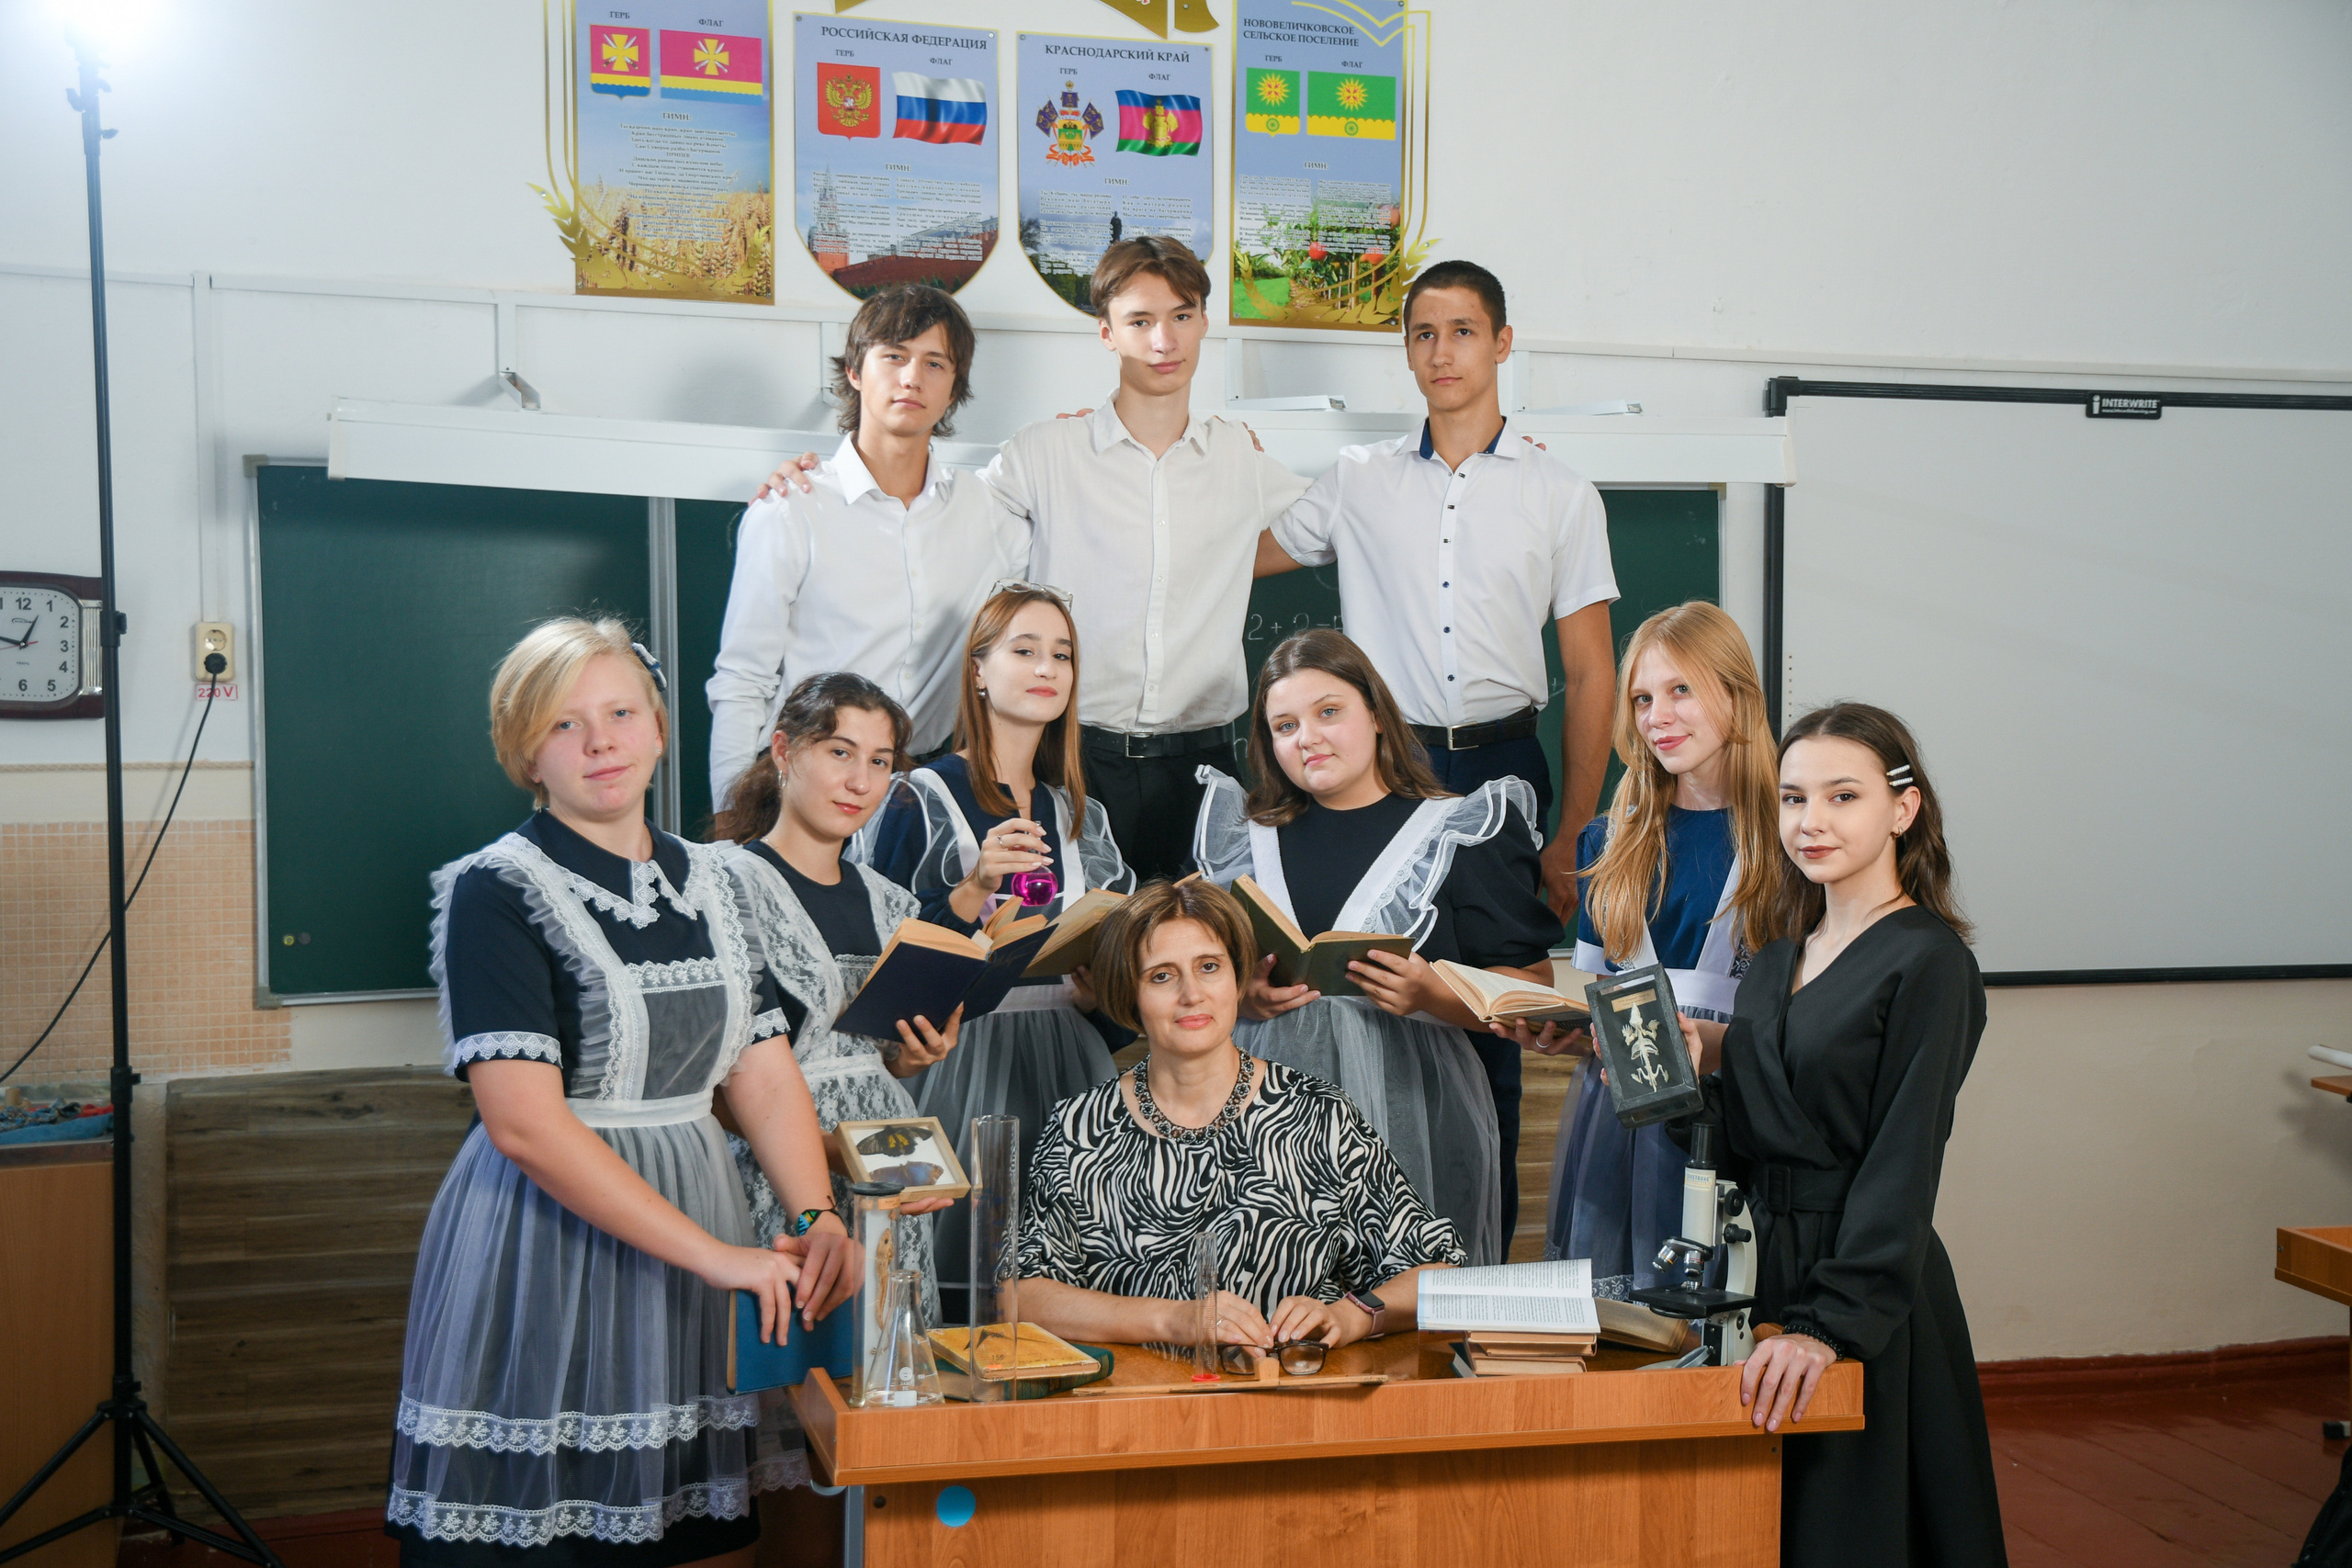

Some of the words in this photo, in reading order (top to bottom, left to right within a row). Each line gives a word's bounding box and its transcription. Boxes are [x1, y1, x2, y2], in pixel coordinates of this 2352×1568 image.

[609, 11, 630, 19] ГЕРБ
[698, 18, 724, 28] ФЛАГ
[1243, 18, 1354, 35] НОВОВЕЛИЧКОВСКОЕ
[821, 26, 909, 43] РОССИЙСКАЯ
[911, 34, 987, 50] ФЕДЕРАЦИЯ
[1243, 30, 1296, 42] СЕЛЬСКОЕ
[1298, 34, 1360, 47] ПОСЕЛЕНИЕ
[835, 49, 854, 57] ГЕРБ
[1045, 45, 1154, 61] КРАСНОДАРСКИЙ
[1158, 51, 1190, 62] КРАЙ
[1264, 54, 1283, 62] ГЕРБ
[930, 57, 953, 65] ФЛАГ
[1341, 61, 1363, 69] ФЛАГ
[1059, 67, 1078, 75] ГЕРБ
[1148, 73, 1171, 81] ФЛАГ
[662, 112, 692, 121] ГИМН:
[885, 164, 912, 172] ГИМН:
[1304, 162, 1329, 170] ГИМН:
[1104, 177, 1130, 186] ГИМН:
[2101, 398, 2157, 409] INTERWRITE
[16, 597, 32, 610] 12
[46, 600, 52, 613] 1
[60, 615, 69, 628] 2
[1249, 614, 1264, 640] 2
[60, 639, 69, 652] 3
[59, 660, 69, 673] 4
[18, 679, 28, 692] 6
[47, 679, 56, 692] 5
[198, 687, 220, 698] 220
[222, 685, 234, 698] V
